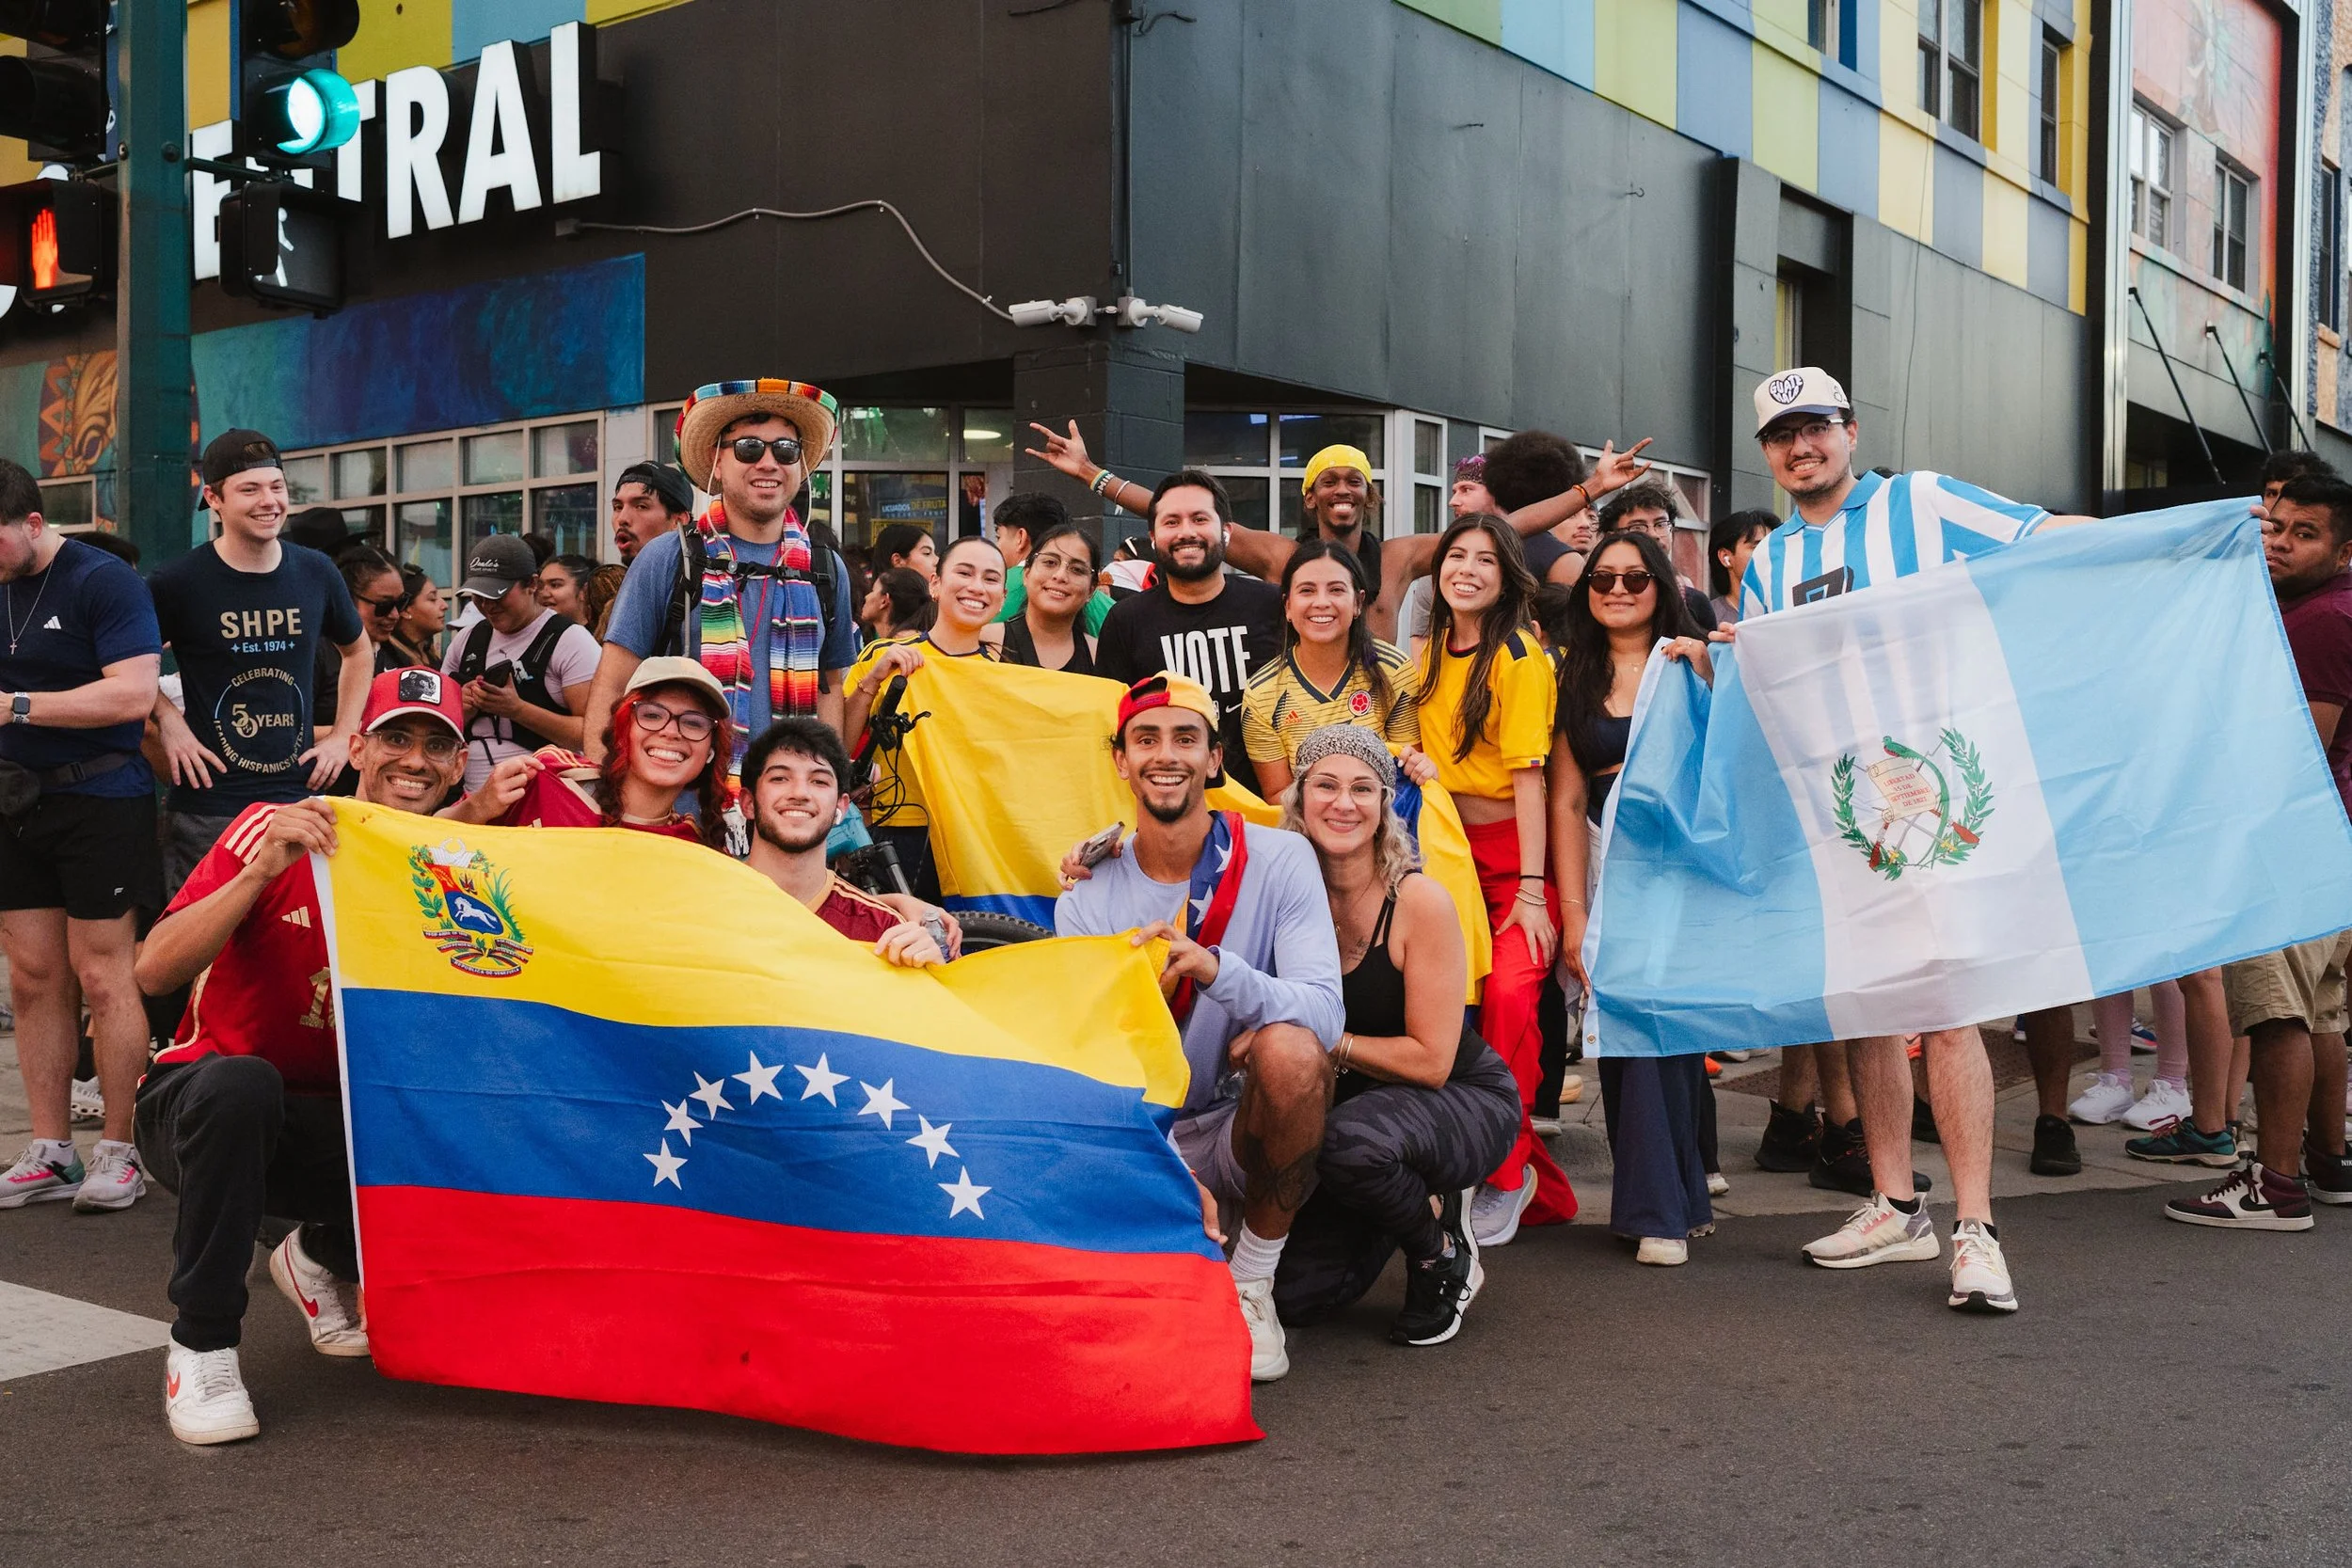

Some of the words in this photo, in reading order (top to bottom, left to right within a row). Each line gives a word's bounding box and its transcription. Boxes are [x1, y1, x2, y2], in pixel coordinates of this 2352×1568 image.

[192, 20, 601, 280] ETRAL
[220, 608, 302, 639] SHPE
[242, 641, 262, 653] Est.
[263, 641, 286, 652] 1974
[1160, 626, 1250, 694] VOTE
[230, 667, 295, 687] CELEBRATING
[230, 703, 259, 738] 50
[256, 713, 294, 727] YEARS
[238, 756, 292, 774] HISPANICS
[299, 966, 336, 1030] 1
